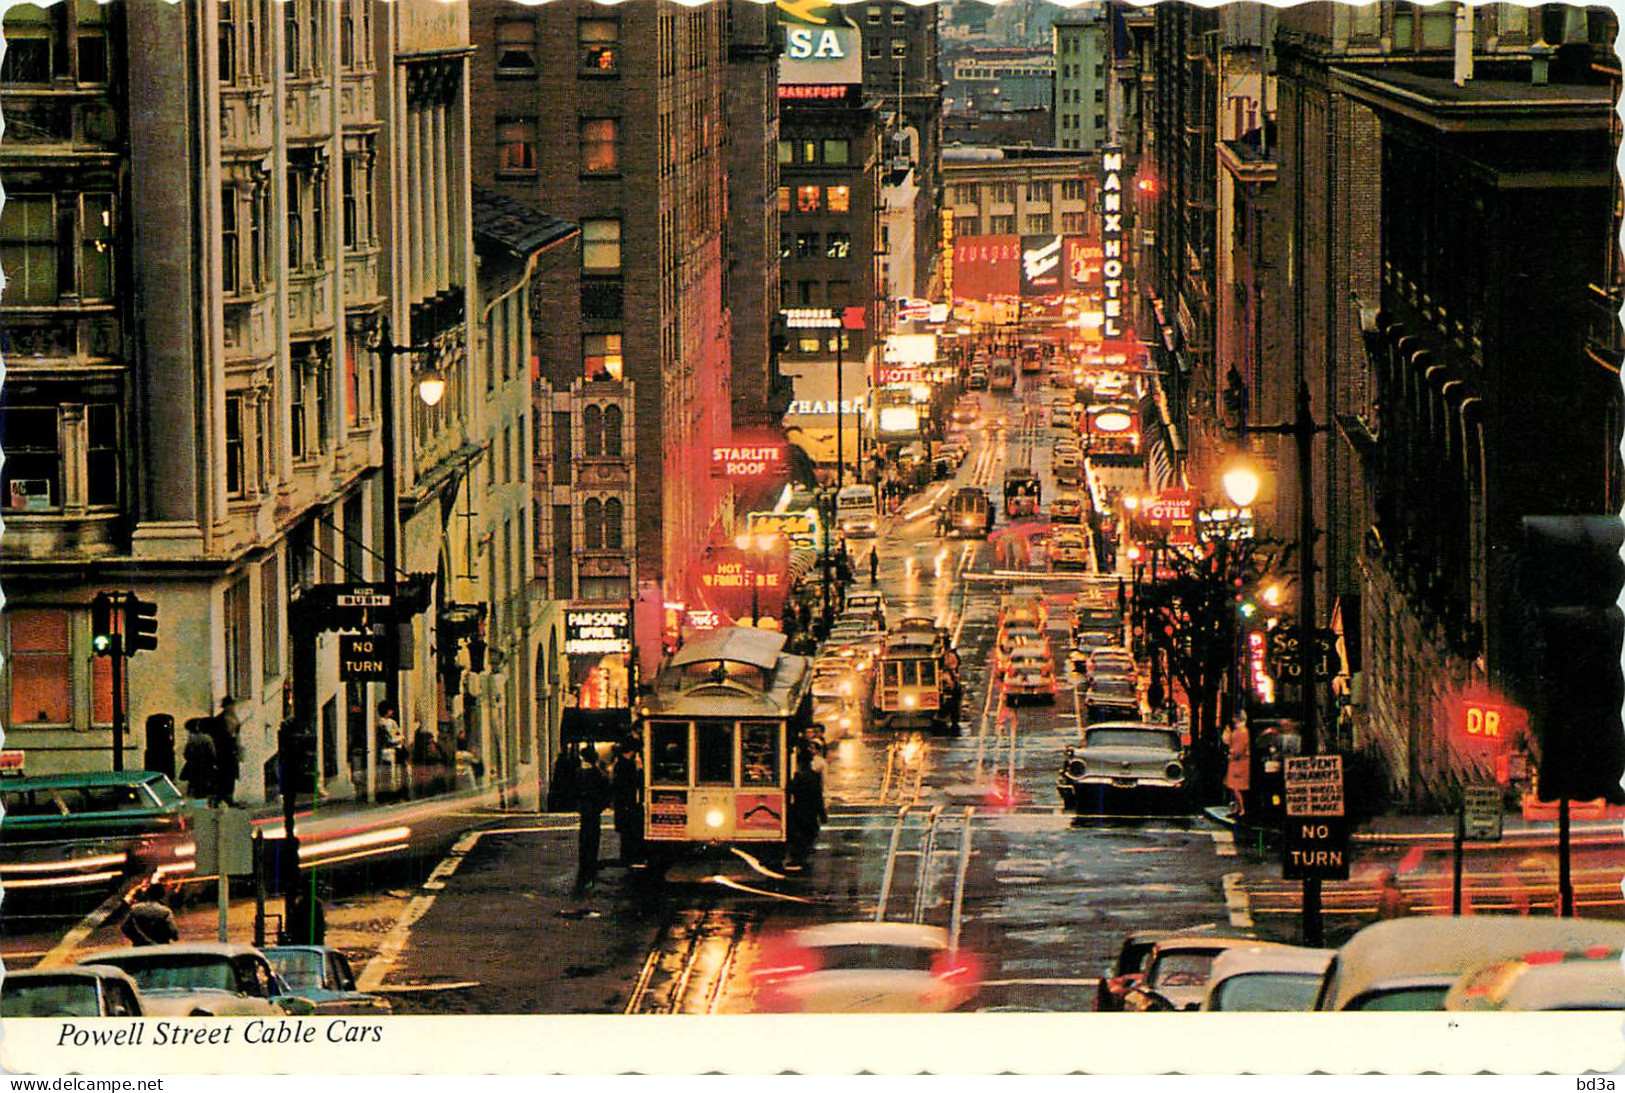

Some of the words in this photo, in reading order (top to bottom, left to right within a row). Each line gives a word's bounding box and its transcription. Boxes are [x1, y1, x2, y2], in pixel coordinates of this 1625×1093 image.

[1103, 153, 1122, 232] MANX
[1103, 240, 1122, 336] HOTEL
[713, 448, 780, 461] STARLITE
[726, 463, 767, 475] ROOF
[568, 612, 628, 627] PARSONS
[352, 641, 373, 653] NO
[1273, 633, 1330, 652] Ses
[345, 660, 383, 672] TURN
[1271, 654, 1329, 678] Fod
[1288, 760, 1338, 771] PREVENT
[1302, 825, 1329, 839] NO
[1291, 851, 1342, 867] TURN
